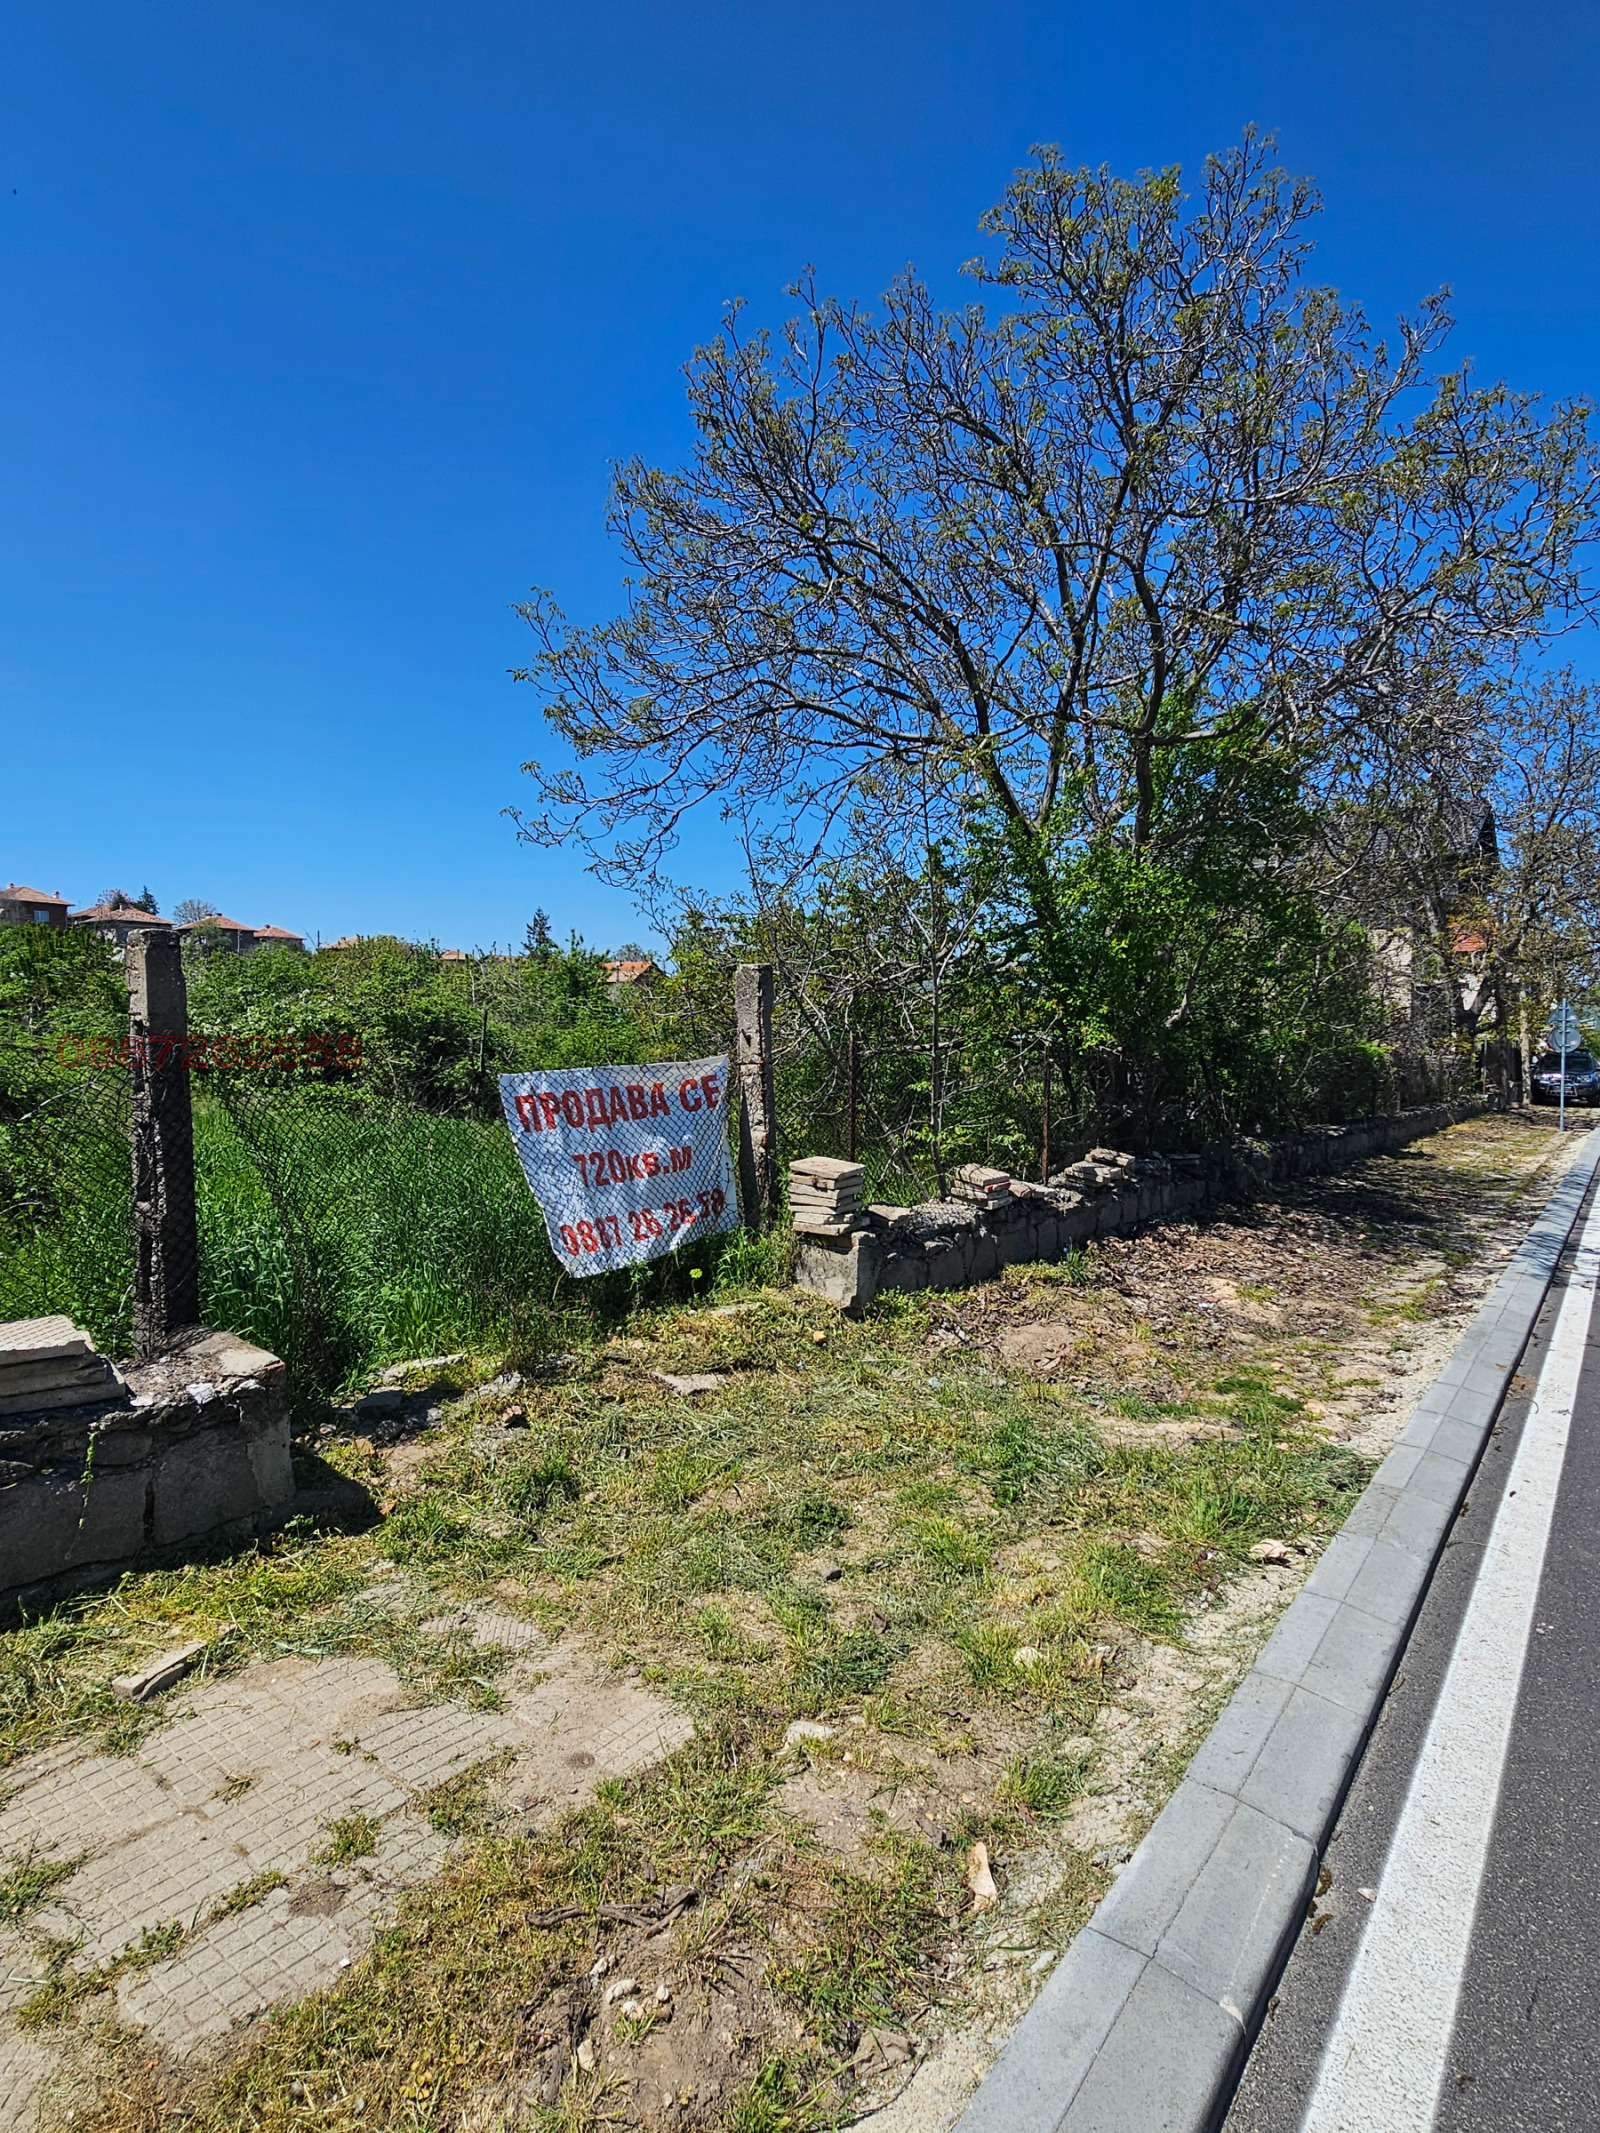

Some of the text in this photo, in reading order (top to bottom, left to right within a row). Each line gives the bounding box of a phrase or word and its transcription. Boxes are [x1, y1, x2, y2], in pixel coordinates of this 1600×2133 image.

[515, 1075, 719, 1133] ПРОДАВА СЕ
[560, 1186, 725, 1256] 0887 26 26 58
